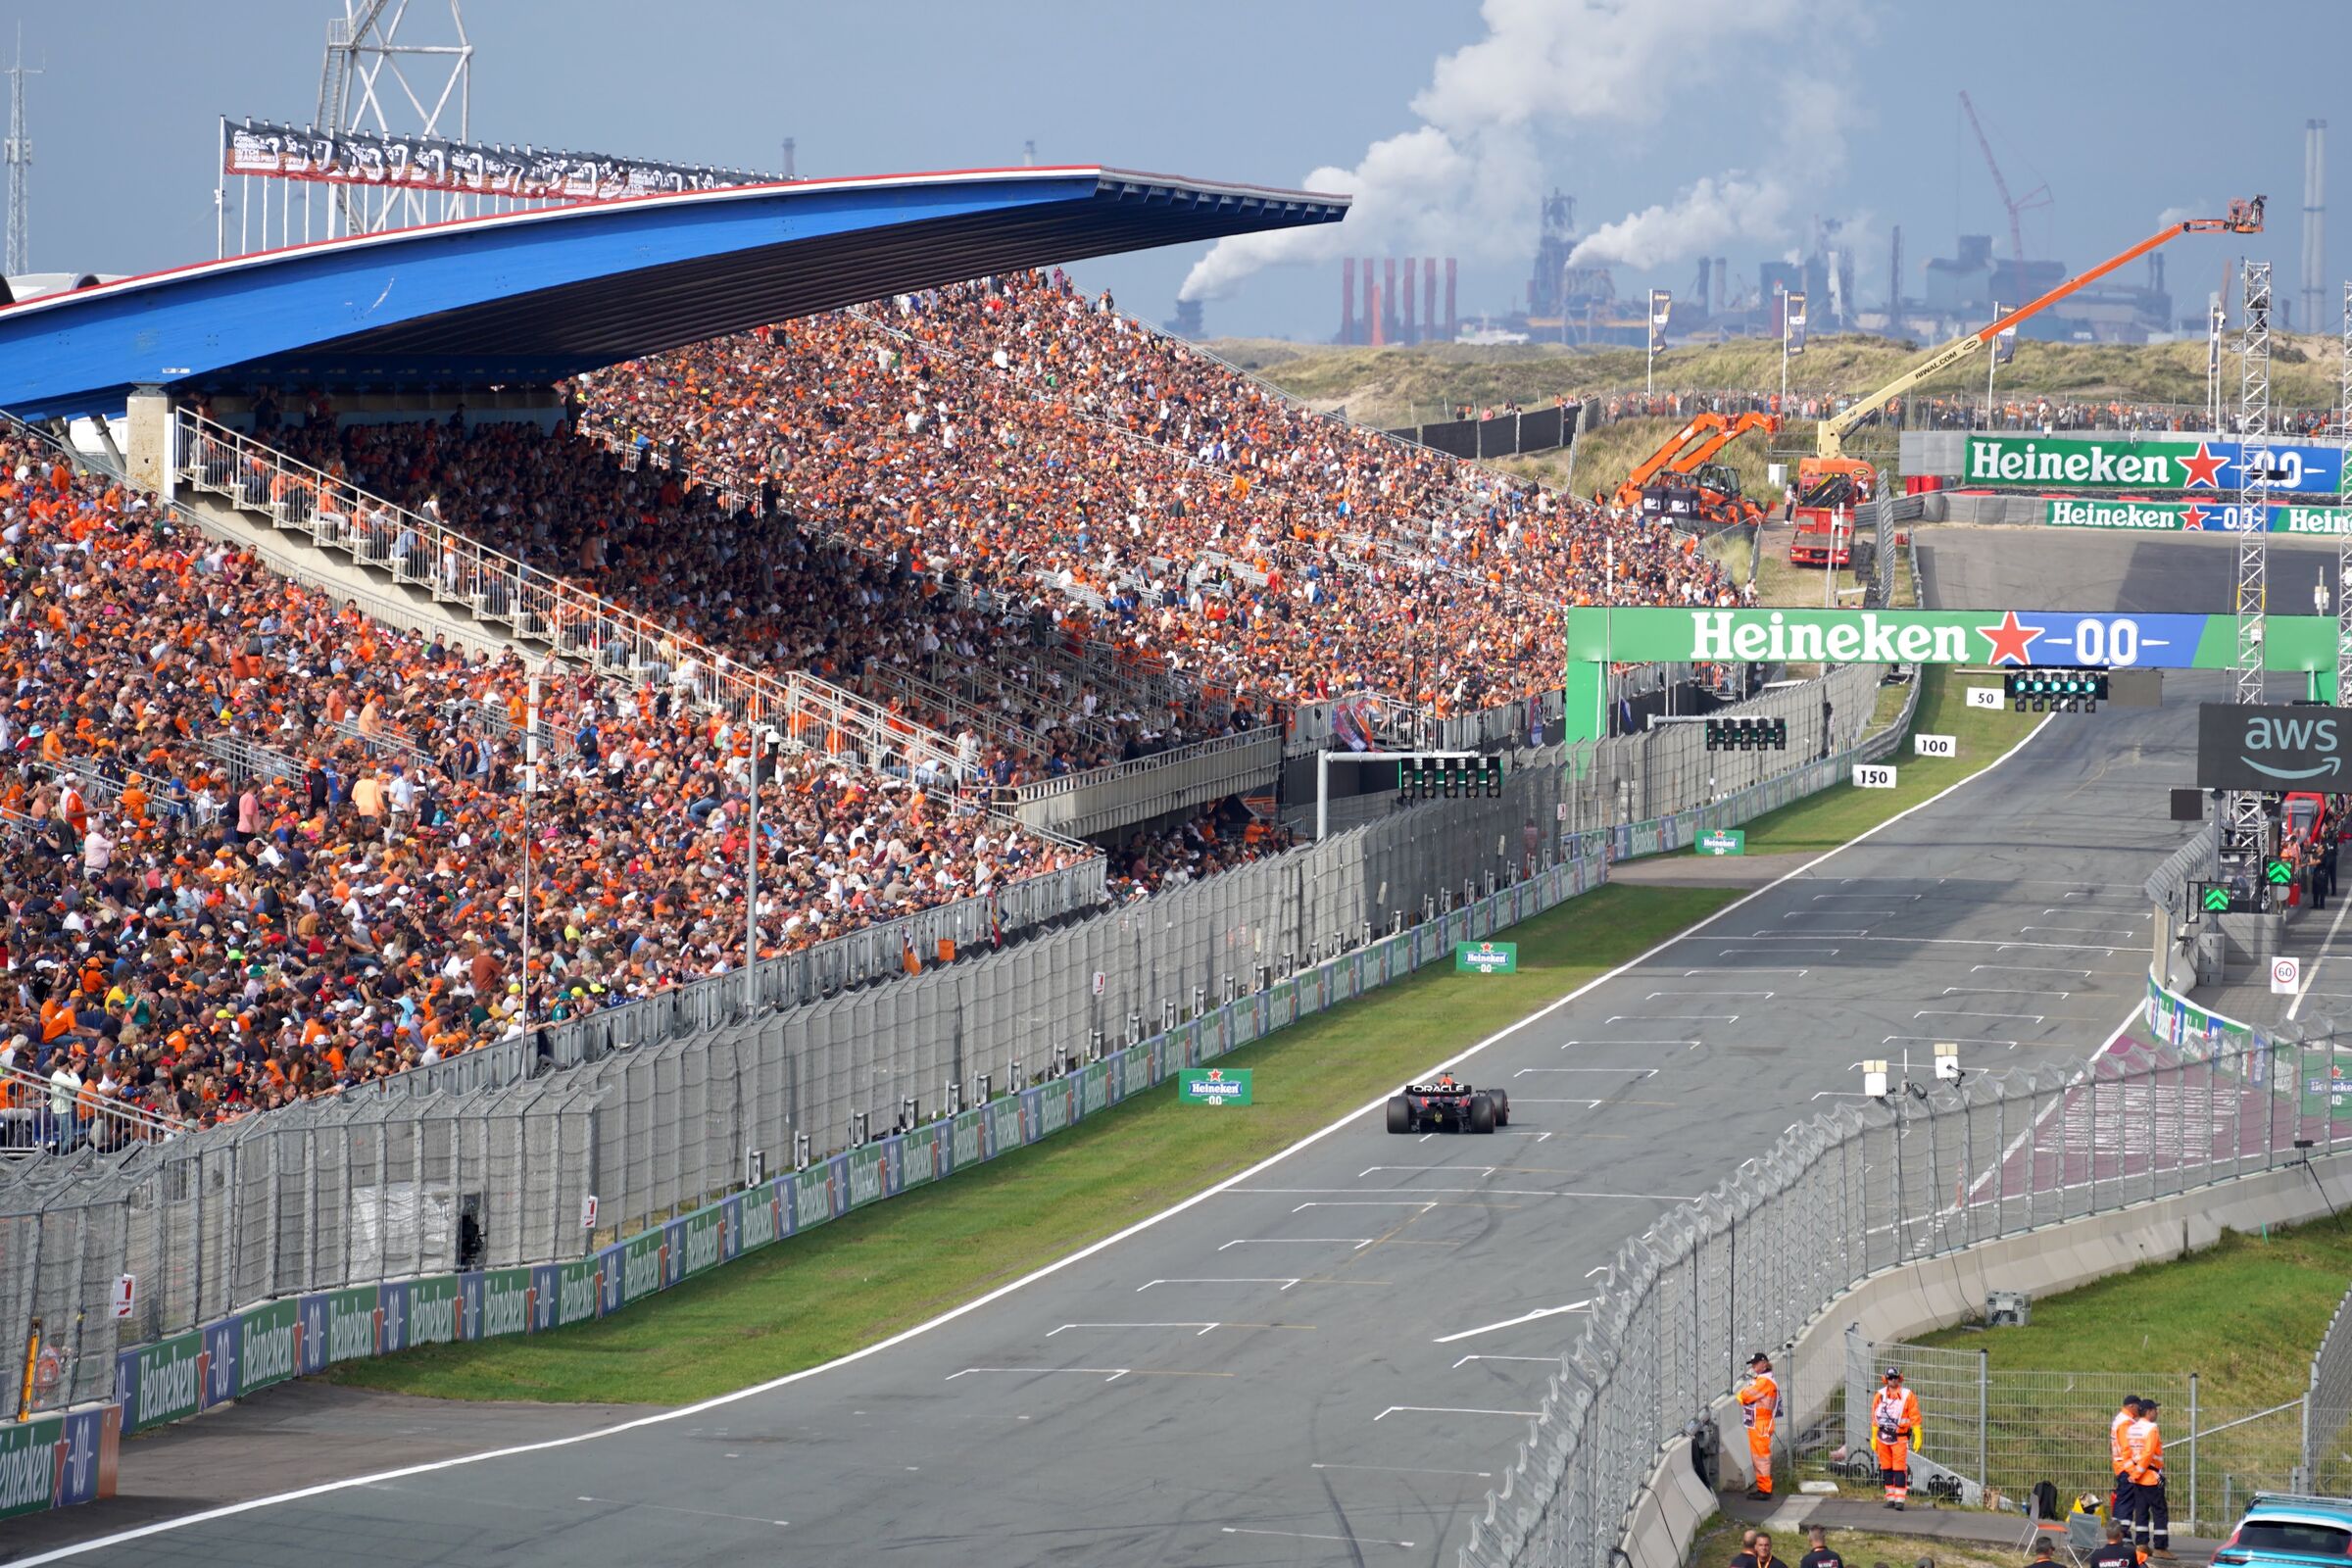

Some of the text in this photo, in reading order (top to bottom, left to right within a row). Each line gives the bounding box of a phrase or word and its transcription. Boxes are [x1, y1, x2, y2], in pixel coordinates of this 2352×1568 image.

[1915, 351, 1958, 380] RIWAL.COM
[1971, 442, 2170, 484] Heineken
[2052, 502, 2175, 529] Heineken
[1690, 612, 2139, 665] Heineken 0.0
[1978, 692, 1994, 704] 50
[2245, 716, 2338, 753] aws
[1922, 740, 1948, 753] 100
[1860, 769, 1888, 784] 150
[1467, 954, 1505, 962] Heineken
[2278, 966, 2292, 977] 60
[1192, 1083, 1239, 1094] Heineken
[1412, 1084, 1465, 1093] ORACLE
[139, 1346, 195, 1422] Heineken
[242, 1312, 292, 1388] Heineken
[329, 1297, 372, 1362] Heineken
[410, 1285, 453, 1348] Heineken
[483, 1277, 525, 1338] Heineken
[559, 1263, 594, 1325] Heineke
[0, 1426, 52, 1509] eineken
